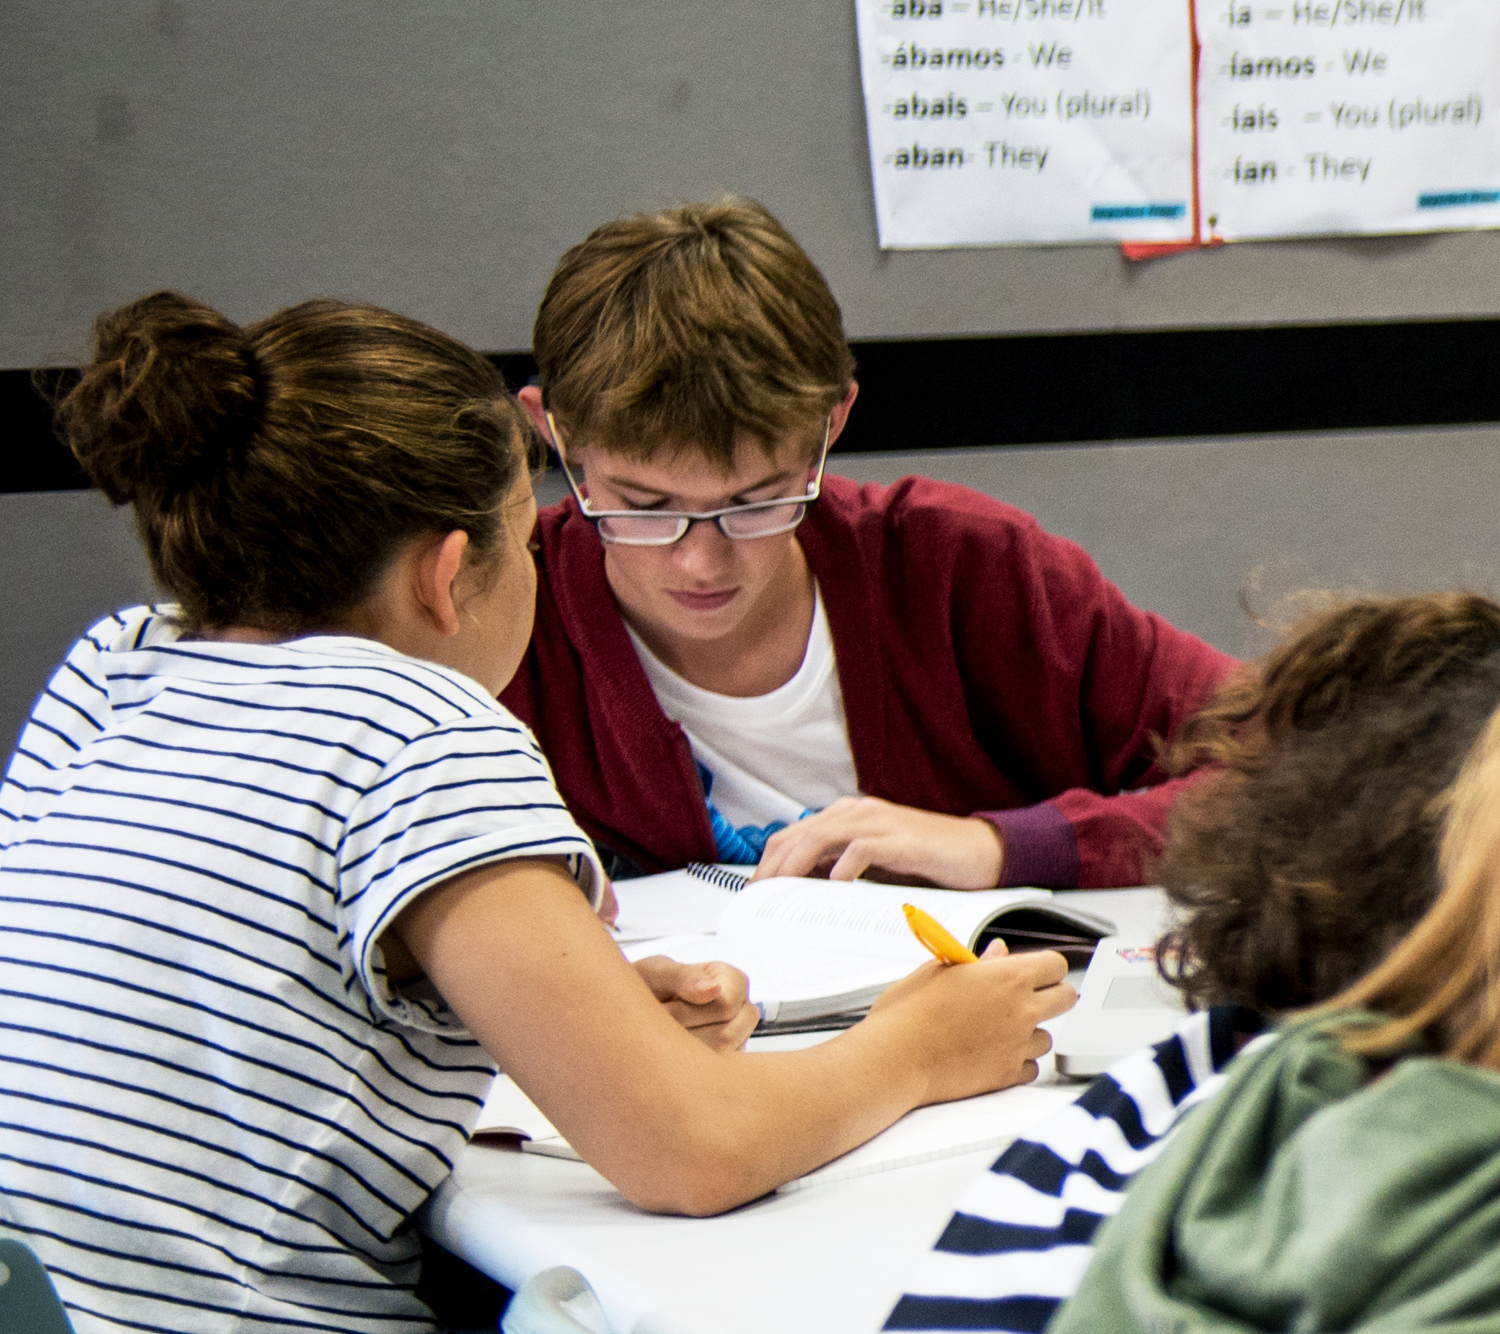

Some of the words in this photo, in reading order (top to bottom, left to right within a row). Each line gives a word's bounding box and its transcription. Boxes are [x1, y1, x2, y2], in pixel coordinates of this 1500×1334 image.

[1001, 94, 1050, 120] You
[1056, 91, 1152, 123] (plural)
[983, 144, 1050, 174] They
[1305, 153, 1372, 184] They
